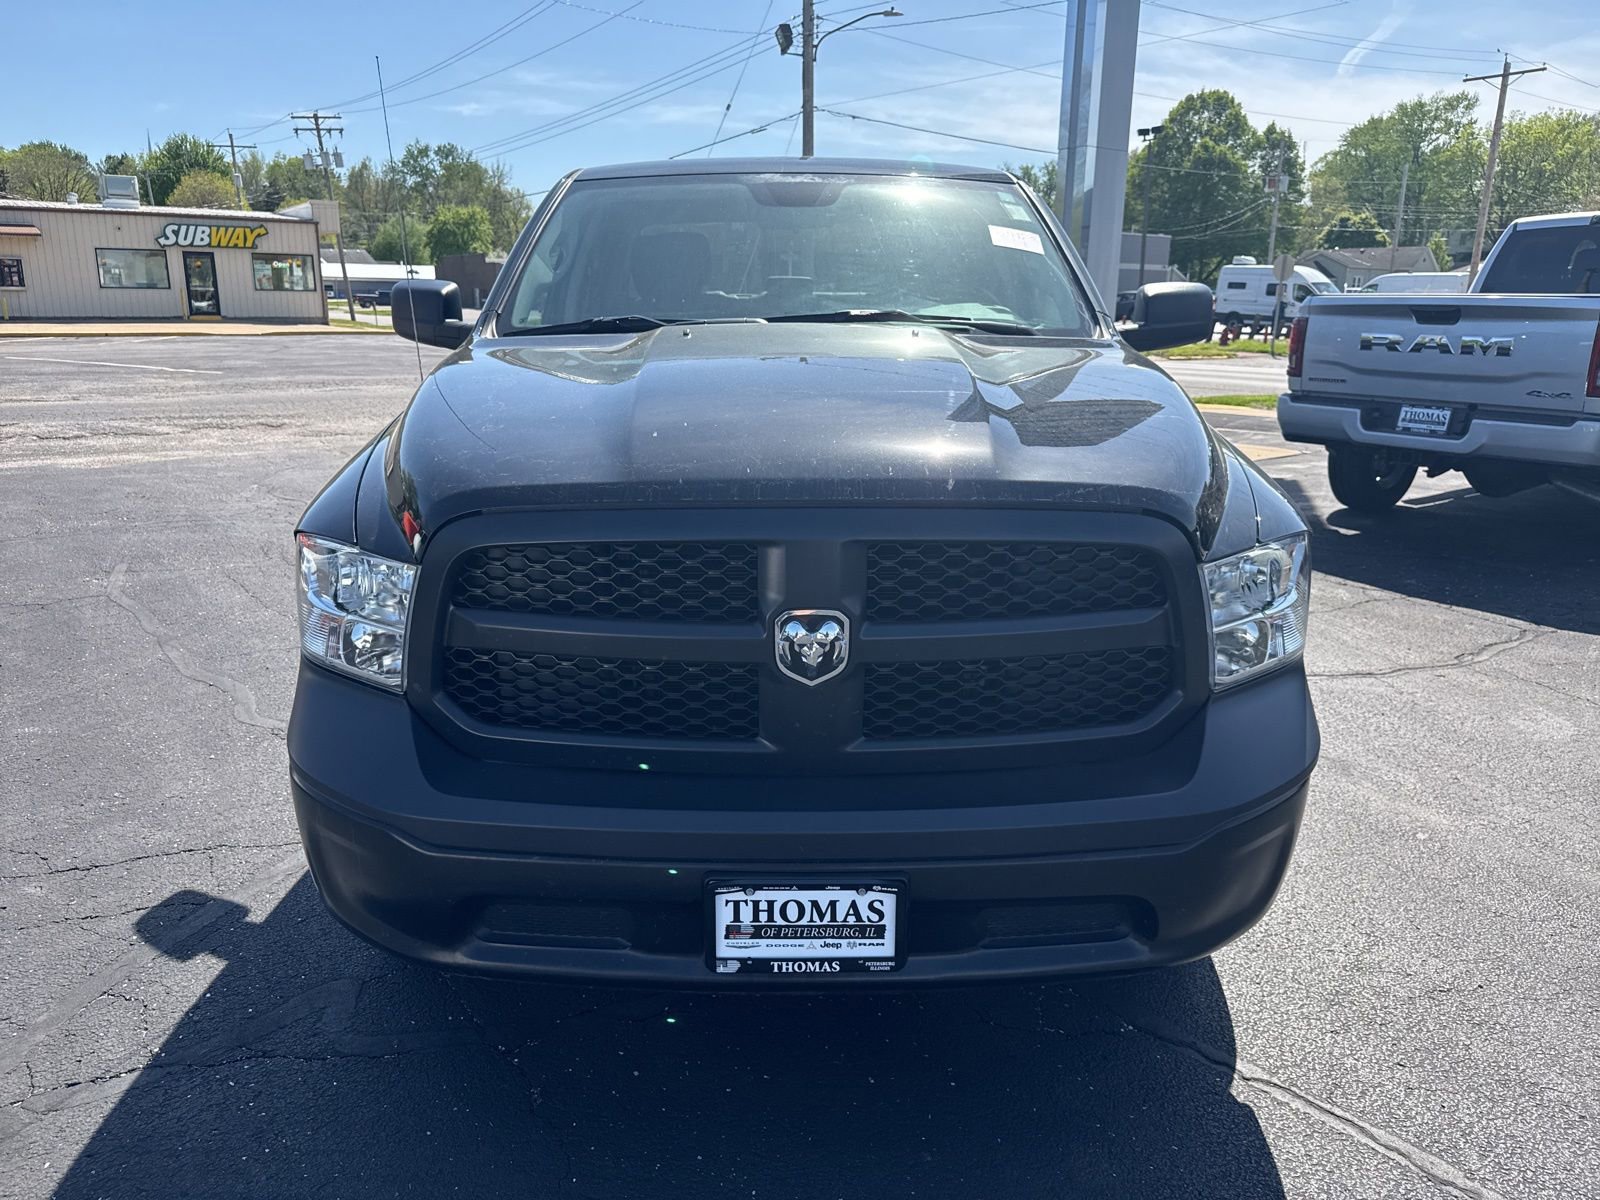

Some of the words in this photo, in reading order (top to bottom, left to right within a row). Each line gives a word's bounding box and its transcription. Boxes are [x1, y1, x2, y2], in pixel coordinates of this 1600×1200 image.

[156, 223, 268, 248] SUBWAY
[1359, 332, 1515, 357] RAM
[1403, 410, 1448, 421] THOMAS
[725, 899, 885, 924] THOMAS
[761, 927, 779, 937] OF
[781, 927, 862, 938] PETERSBURG,
[865, 927, 877, 937] IL
[820, 941, 842, 949] Jeep
[770, 961, 840, 973] THOMAS
